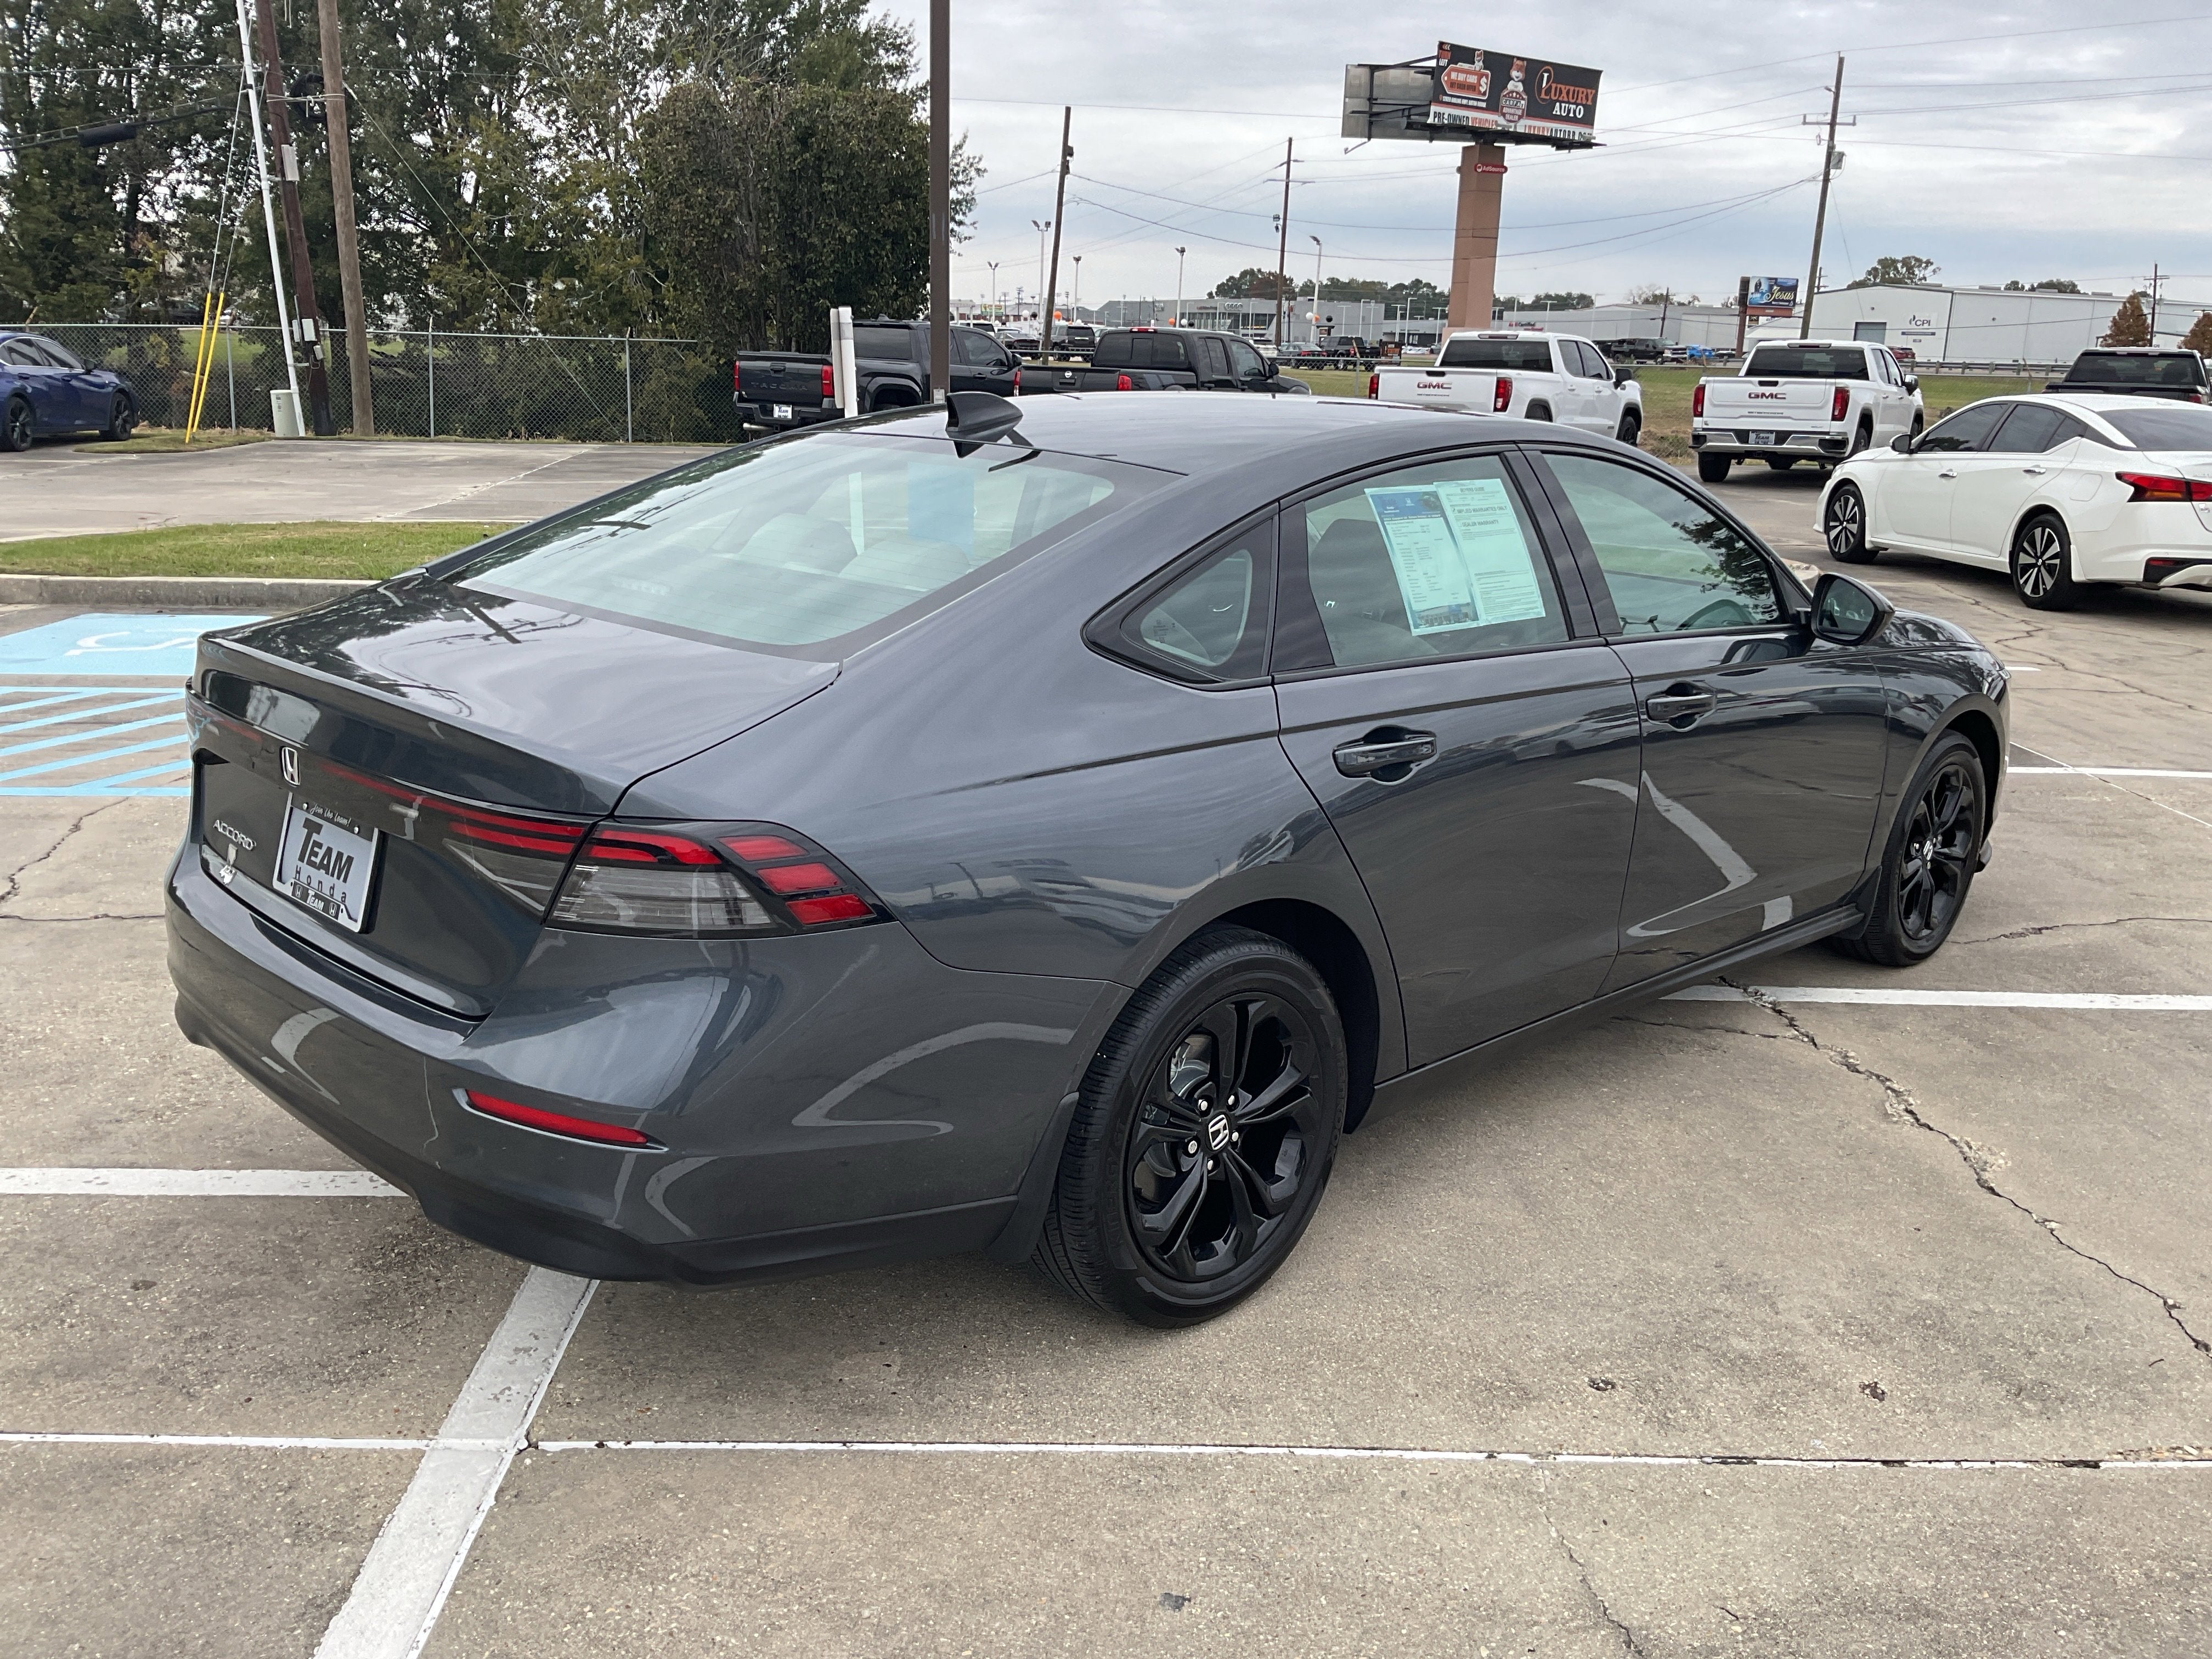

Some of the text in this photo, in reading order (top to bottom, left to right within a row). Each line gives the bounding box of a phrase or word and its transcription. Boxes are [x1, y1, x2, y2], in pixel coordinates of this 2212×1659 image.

[1451, 71, 1477, 83] WE BUY CARS
[1539, 71, 1595, 105] LUXURY
[1502, 99, 1524, 108] CARFAX
[1502, 107, 1522, 115] ADVANTAGE
[1553, 102, 1584, 119] AUTO
[1433, 111, 1498, 129] PRE-OWNED VEHICLES
[1762, 285, 1795, 302] Jesus
[212, 819, 257, 851] ACCORD
[297, 817, 354, 884] TEAM
[295, 864, 347, 904] Honda
[306, 889, 325, 911] TEAM
